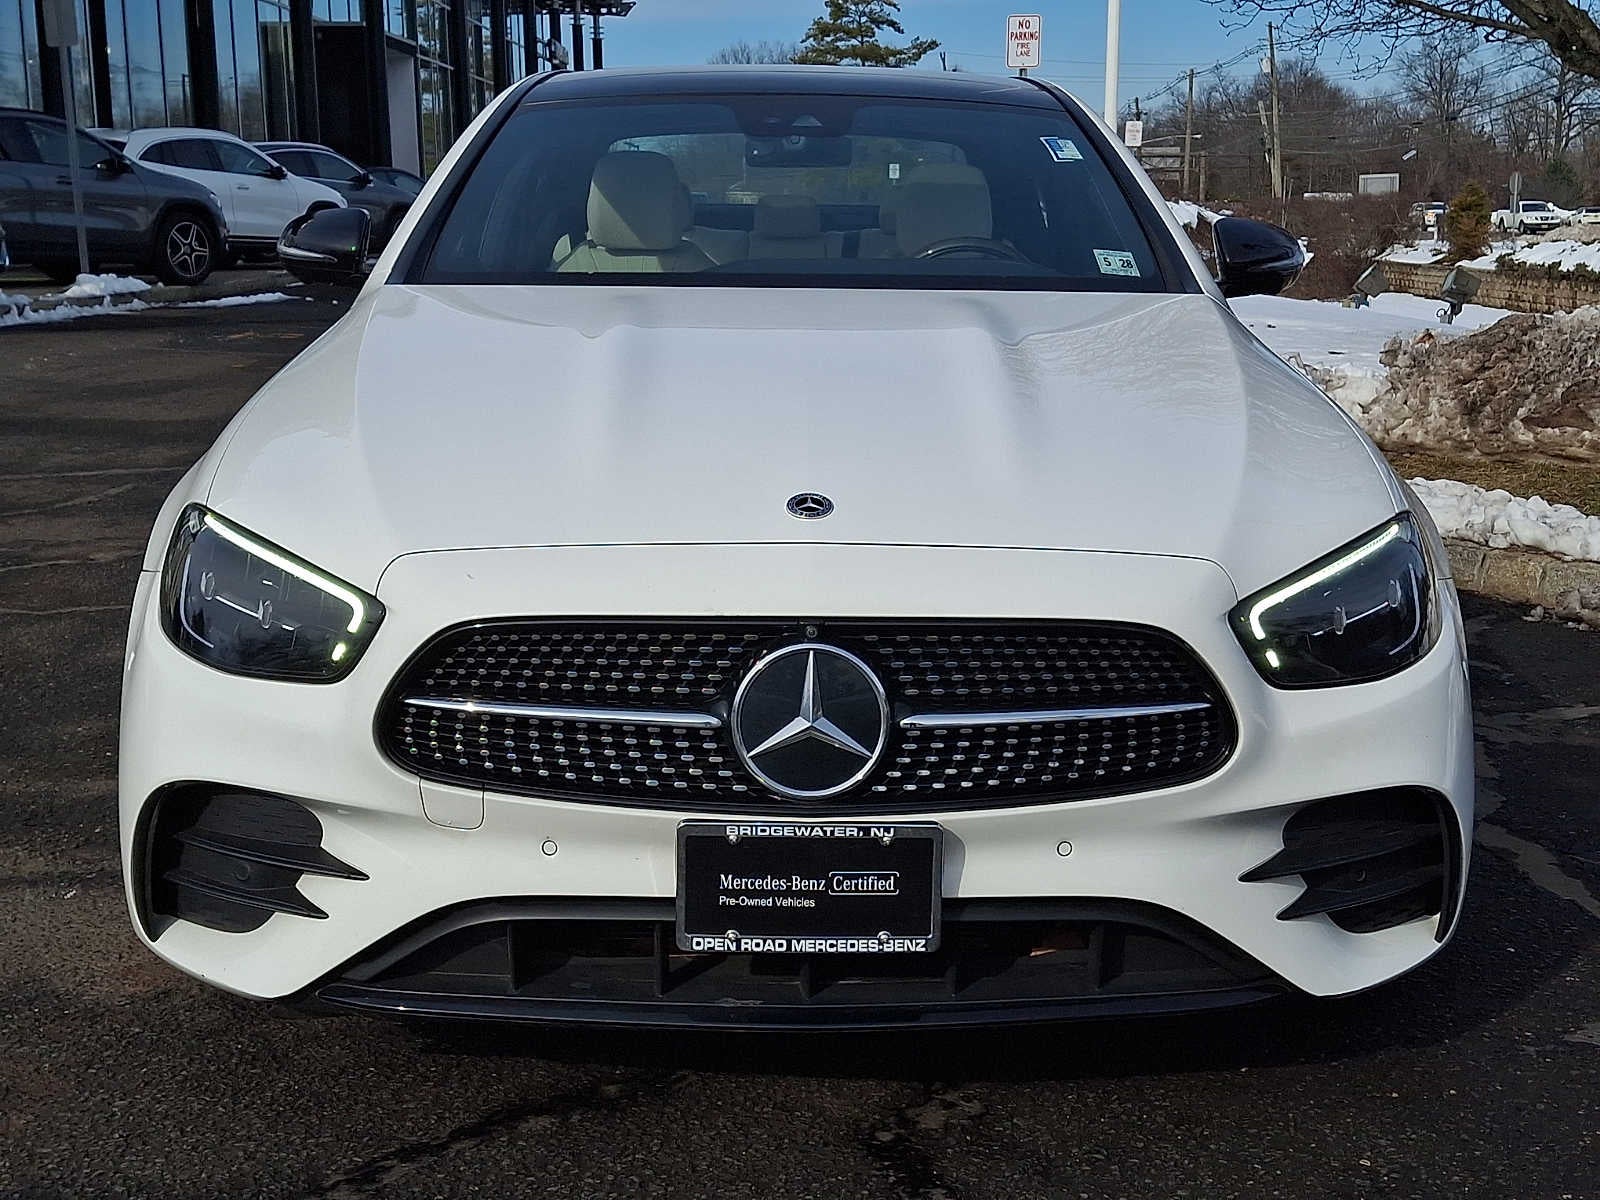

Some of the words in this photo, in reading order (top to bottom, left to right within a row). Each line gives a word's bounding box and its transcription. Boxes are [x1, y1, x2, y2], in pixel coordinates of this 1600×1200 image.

[1018, 20, 1030, 30] NO
[1010, 32, 1038, 40] PARKING
[1118, 258, 1133, 268] 28
[726, 826, 864, 837] BRIDGEWATER,
[870, 827, 895, 837] NJ
[719, 874, 826, 891] Mercedes-Benz
[833, 876, 895, 891] Certified
[719, 896, 773, 907] Pre-Owned
[775, 897, 816, 908] Vehicles
[692, 937, 737, 951] OPEN
[740, 939, 787, 952] ROAD
